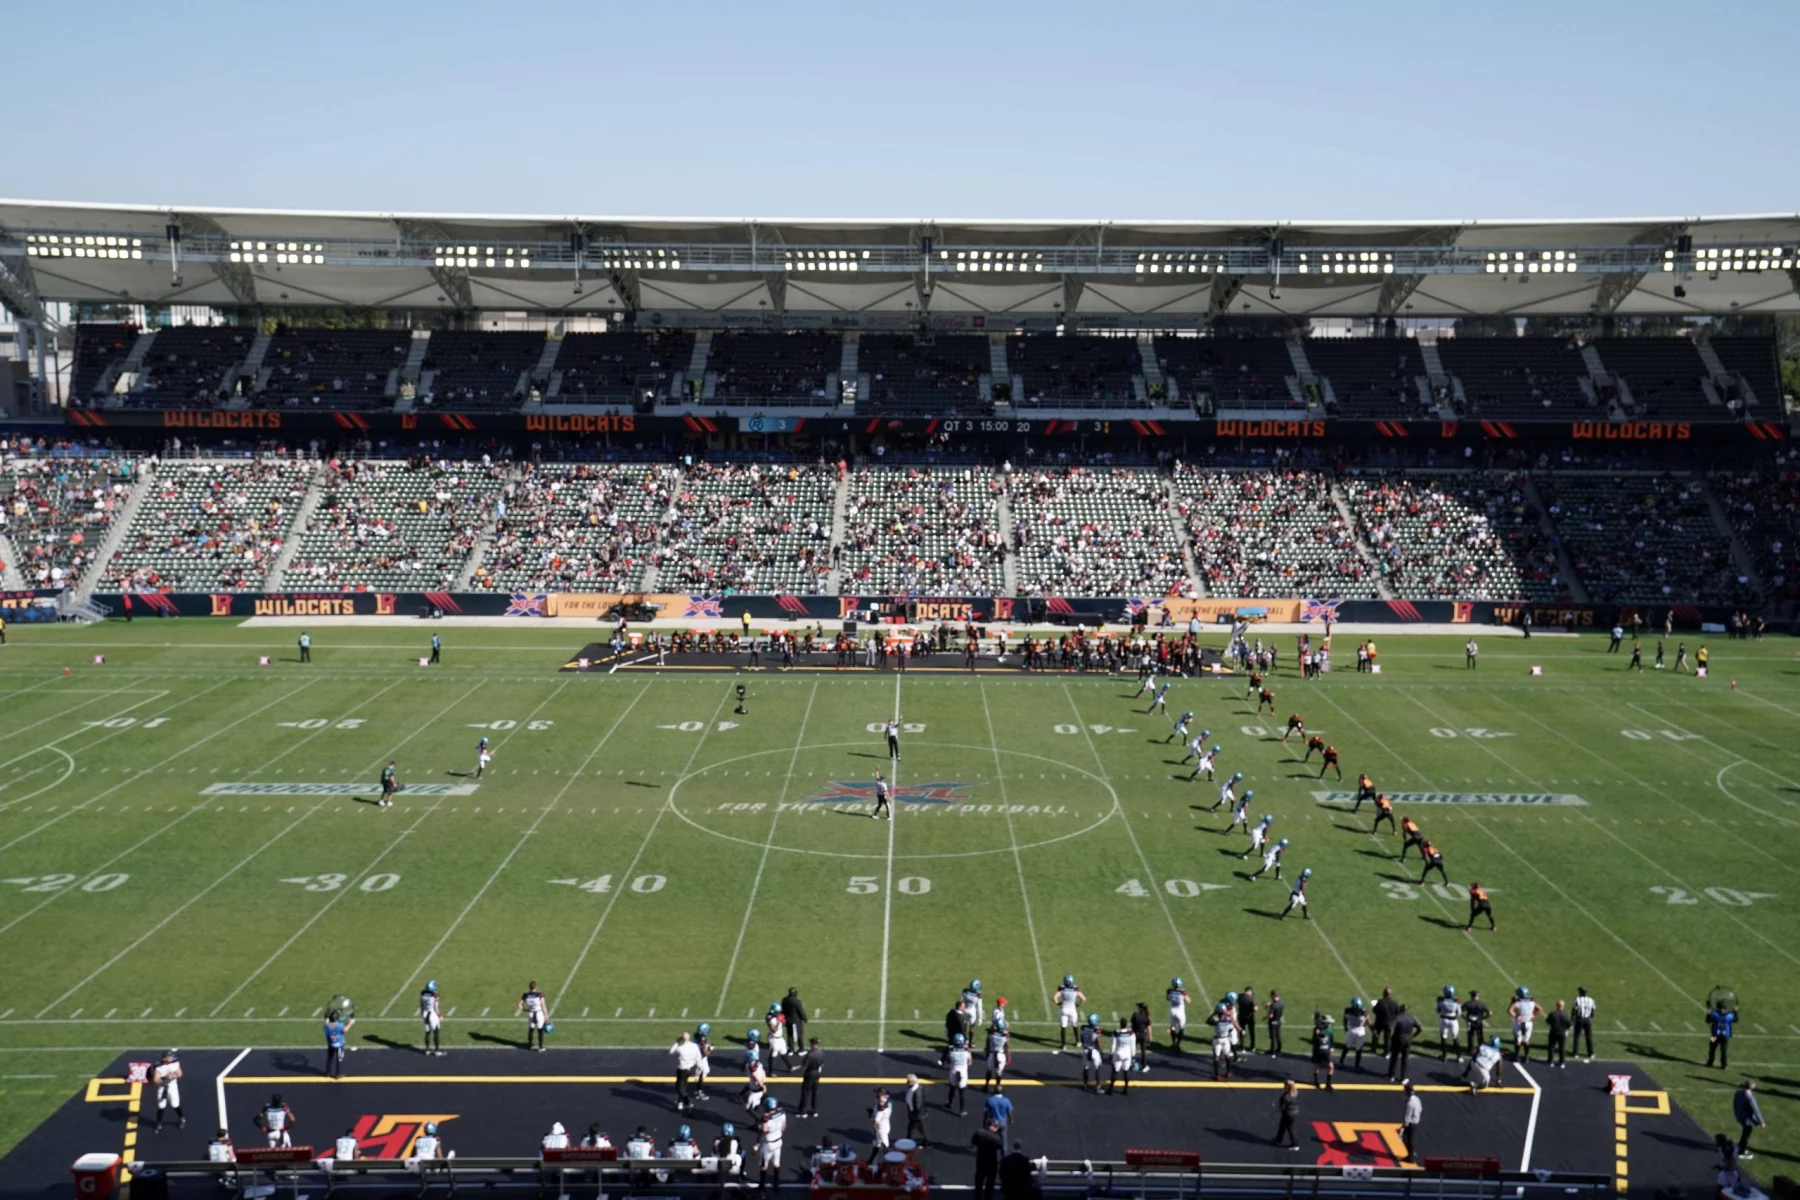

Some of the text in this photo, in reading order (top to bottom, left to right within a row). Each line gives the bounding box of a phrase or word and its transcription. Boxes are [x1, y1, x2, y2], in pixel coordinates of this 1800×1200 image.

[163, 412, 281, 429] WILDCATS
[527, 415, 635, 431] WILDCATS
[778, 420, 786, 430] 3
[943, 421, 1030, 432] QT 3 15:00 20
[1094, 422, 1101, 431] 3
[1216, 421, 1325, 437] WILDCATS
[1572, 422, 1691, 439] WILDCATS
[255, 599, 354, 615] WILDCATS
[564, 601, 580, 609] FOR
[582, 601, 595, 609] THE
[718, 802, 767, 811] FOR
[777, 802, 825, 811] THE
[904, 804, 933, 812] OF
[945, 804, 1068, 813] FOOTBALL
[20, 872, 130, 893] 20
[303, 872, 402, 893] 30
[578, 873, 668, 893] 40
[845, 875, 932, 895] 50
[1115, 877, 1201, 898] 40
[1649, 884, 1754, 907] 20
[80, 1176, 96, 1193] G
